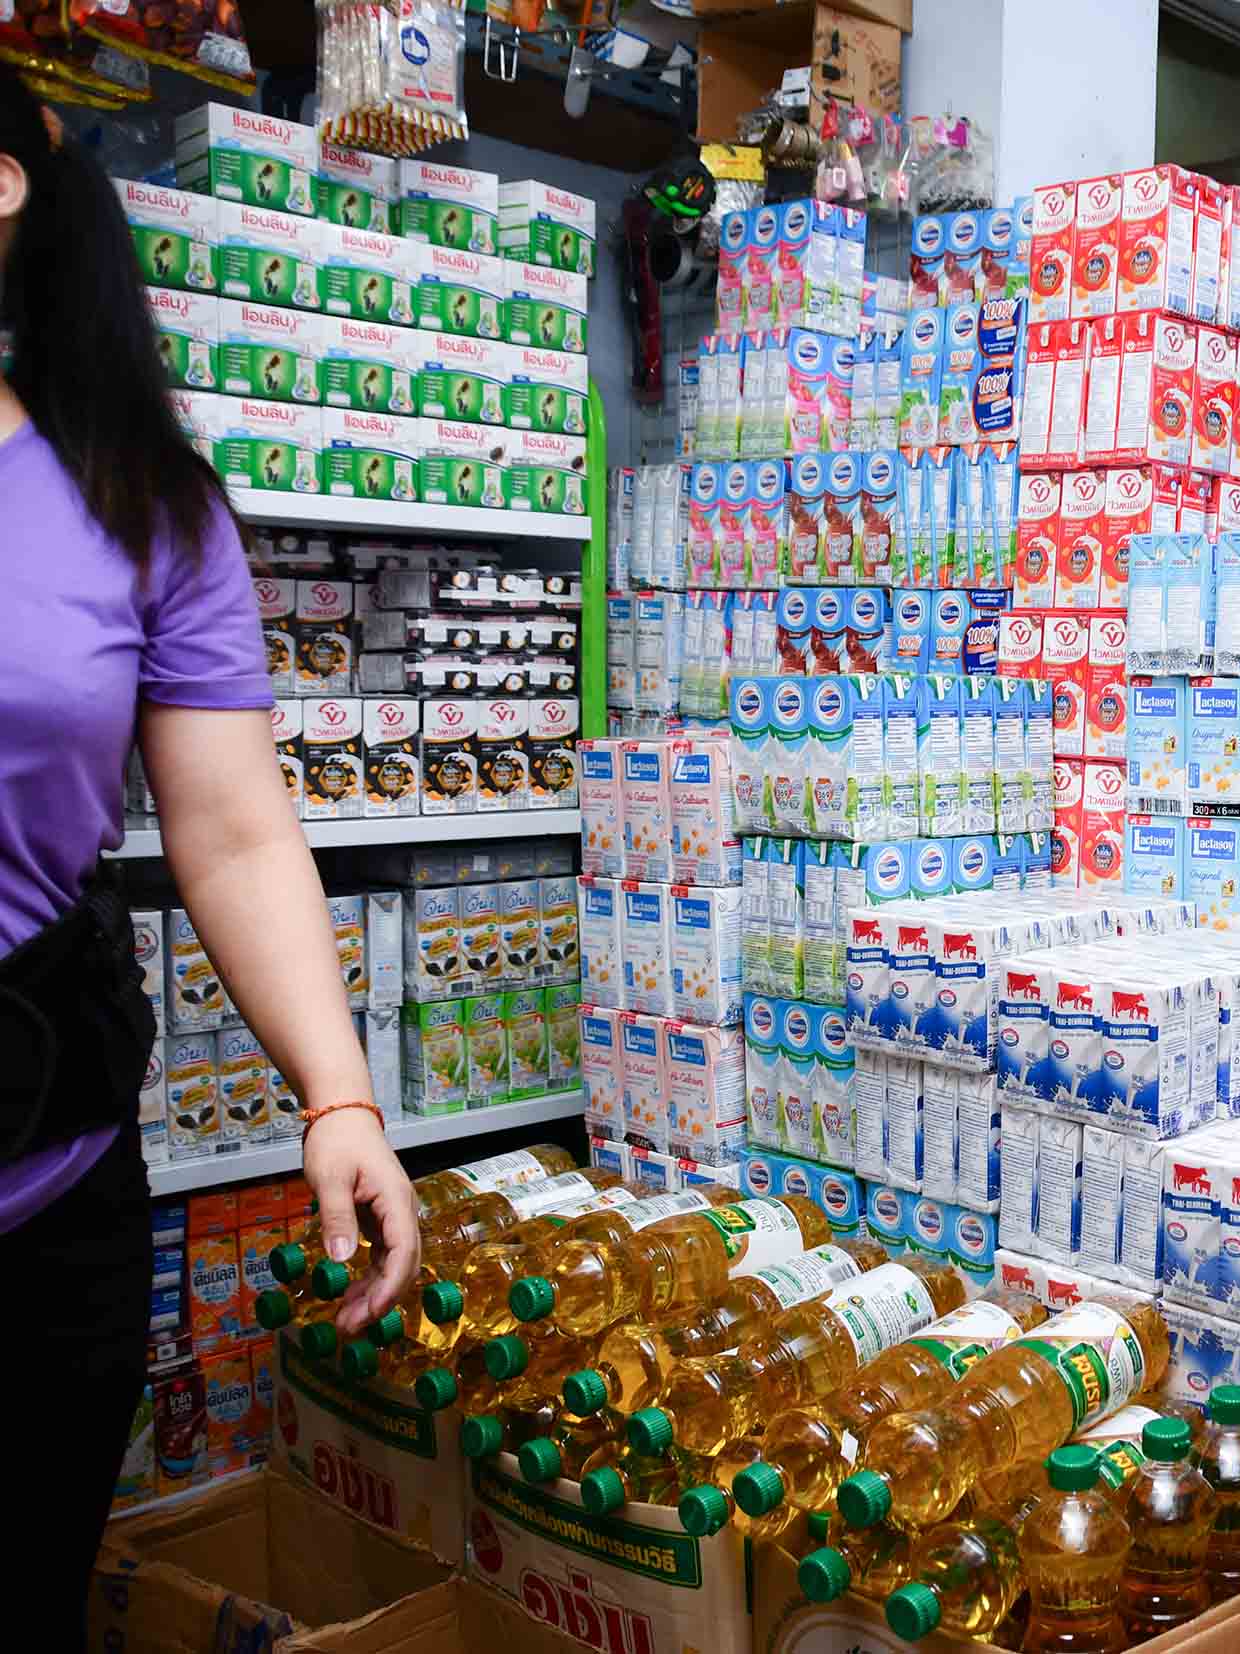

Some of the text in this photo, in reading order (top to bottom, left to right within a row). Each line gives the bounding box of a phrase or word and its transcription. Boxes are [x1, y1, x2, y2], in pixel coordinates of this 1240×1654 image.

[967, 627, 998, 645] 100%
[1135, 690, 1175, 714] Lactasoy
[1195, 690, 1236, 715] Lactasoy
[1194, 805, 1209, 815] 300
[1134, 829, 1174, 852] Lactasoy
[1193, 831, 1234, 856] Lactasoy
[1056, 1017, 1093, 1027] THAI-DENMARK
[1109, 1027, 1150, 1037] THAI-DENMARK
[1172, 1199, 1211, 1209] THAI-DENMARK
